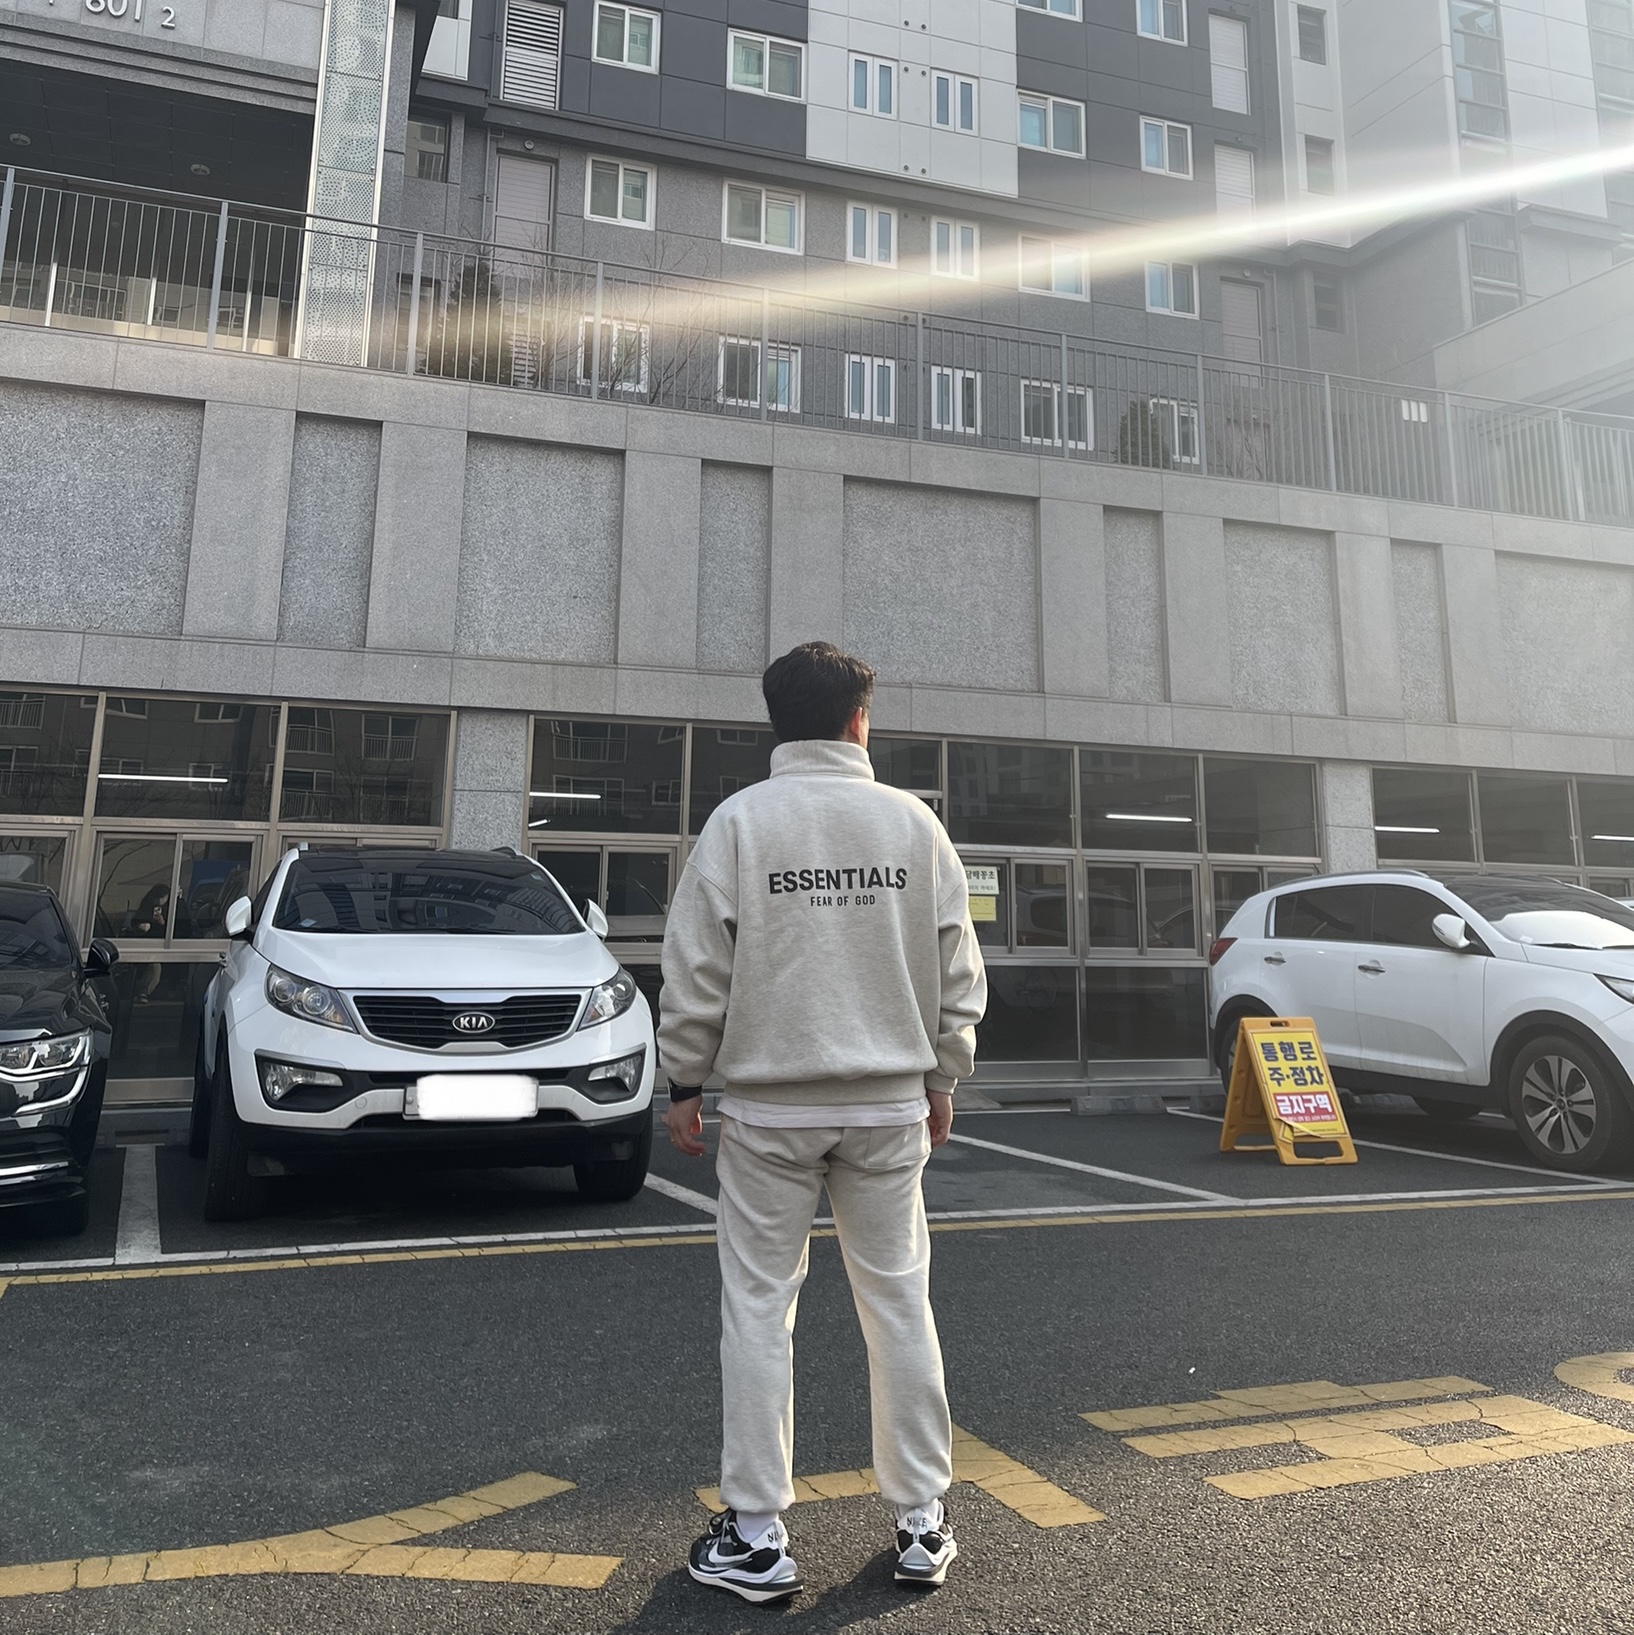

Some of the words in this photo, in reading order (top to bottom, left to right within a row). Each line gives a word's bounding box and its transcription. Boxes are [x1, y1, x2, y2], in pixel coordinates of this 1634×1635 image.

[769, 866, 908, 895] ESSENTIALS
[811, 896, 833, 907] FEAR
[837, 896, 849, 907] OF
[854, 895, 876, 906] GOD
[459, 1016, 488, 1029] KIA
[1261, 1041, 1318, 1062] 통행로
[1267, 1065, 1325, 1087] 주·정차
[1275, 1093, 1333, 1115] 금지구역
